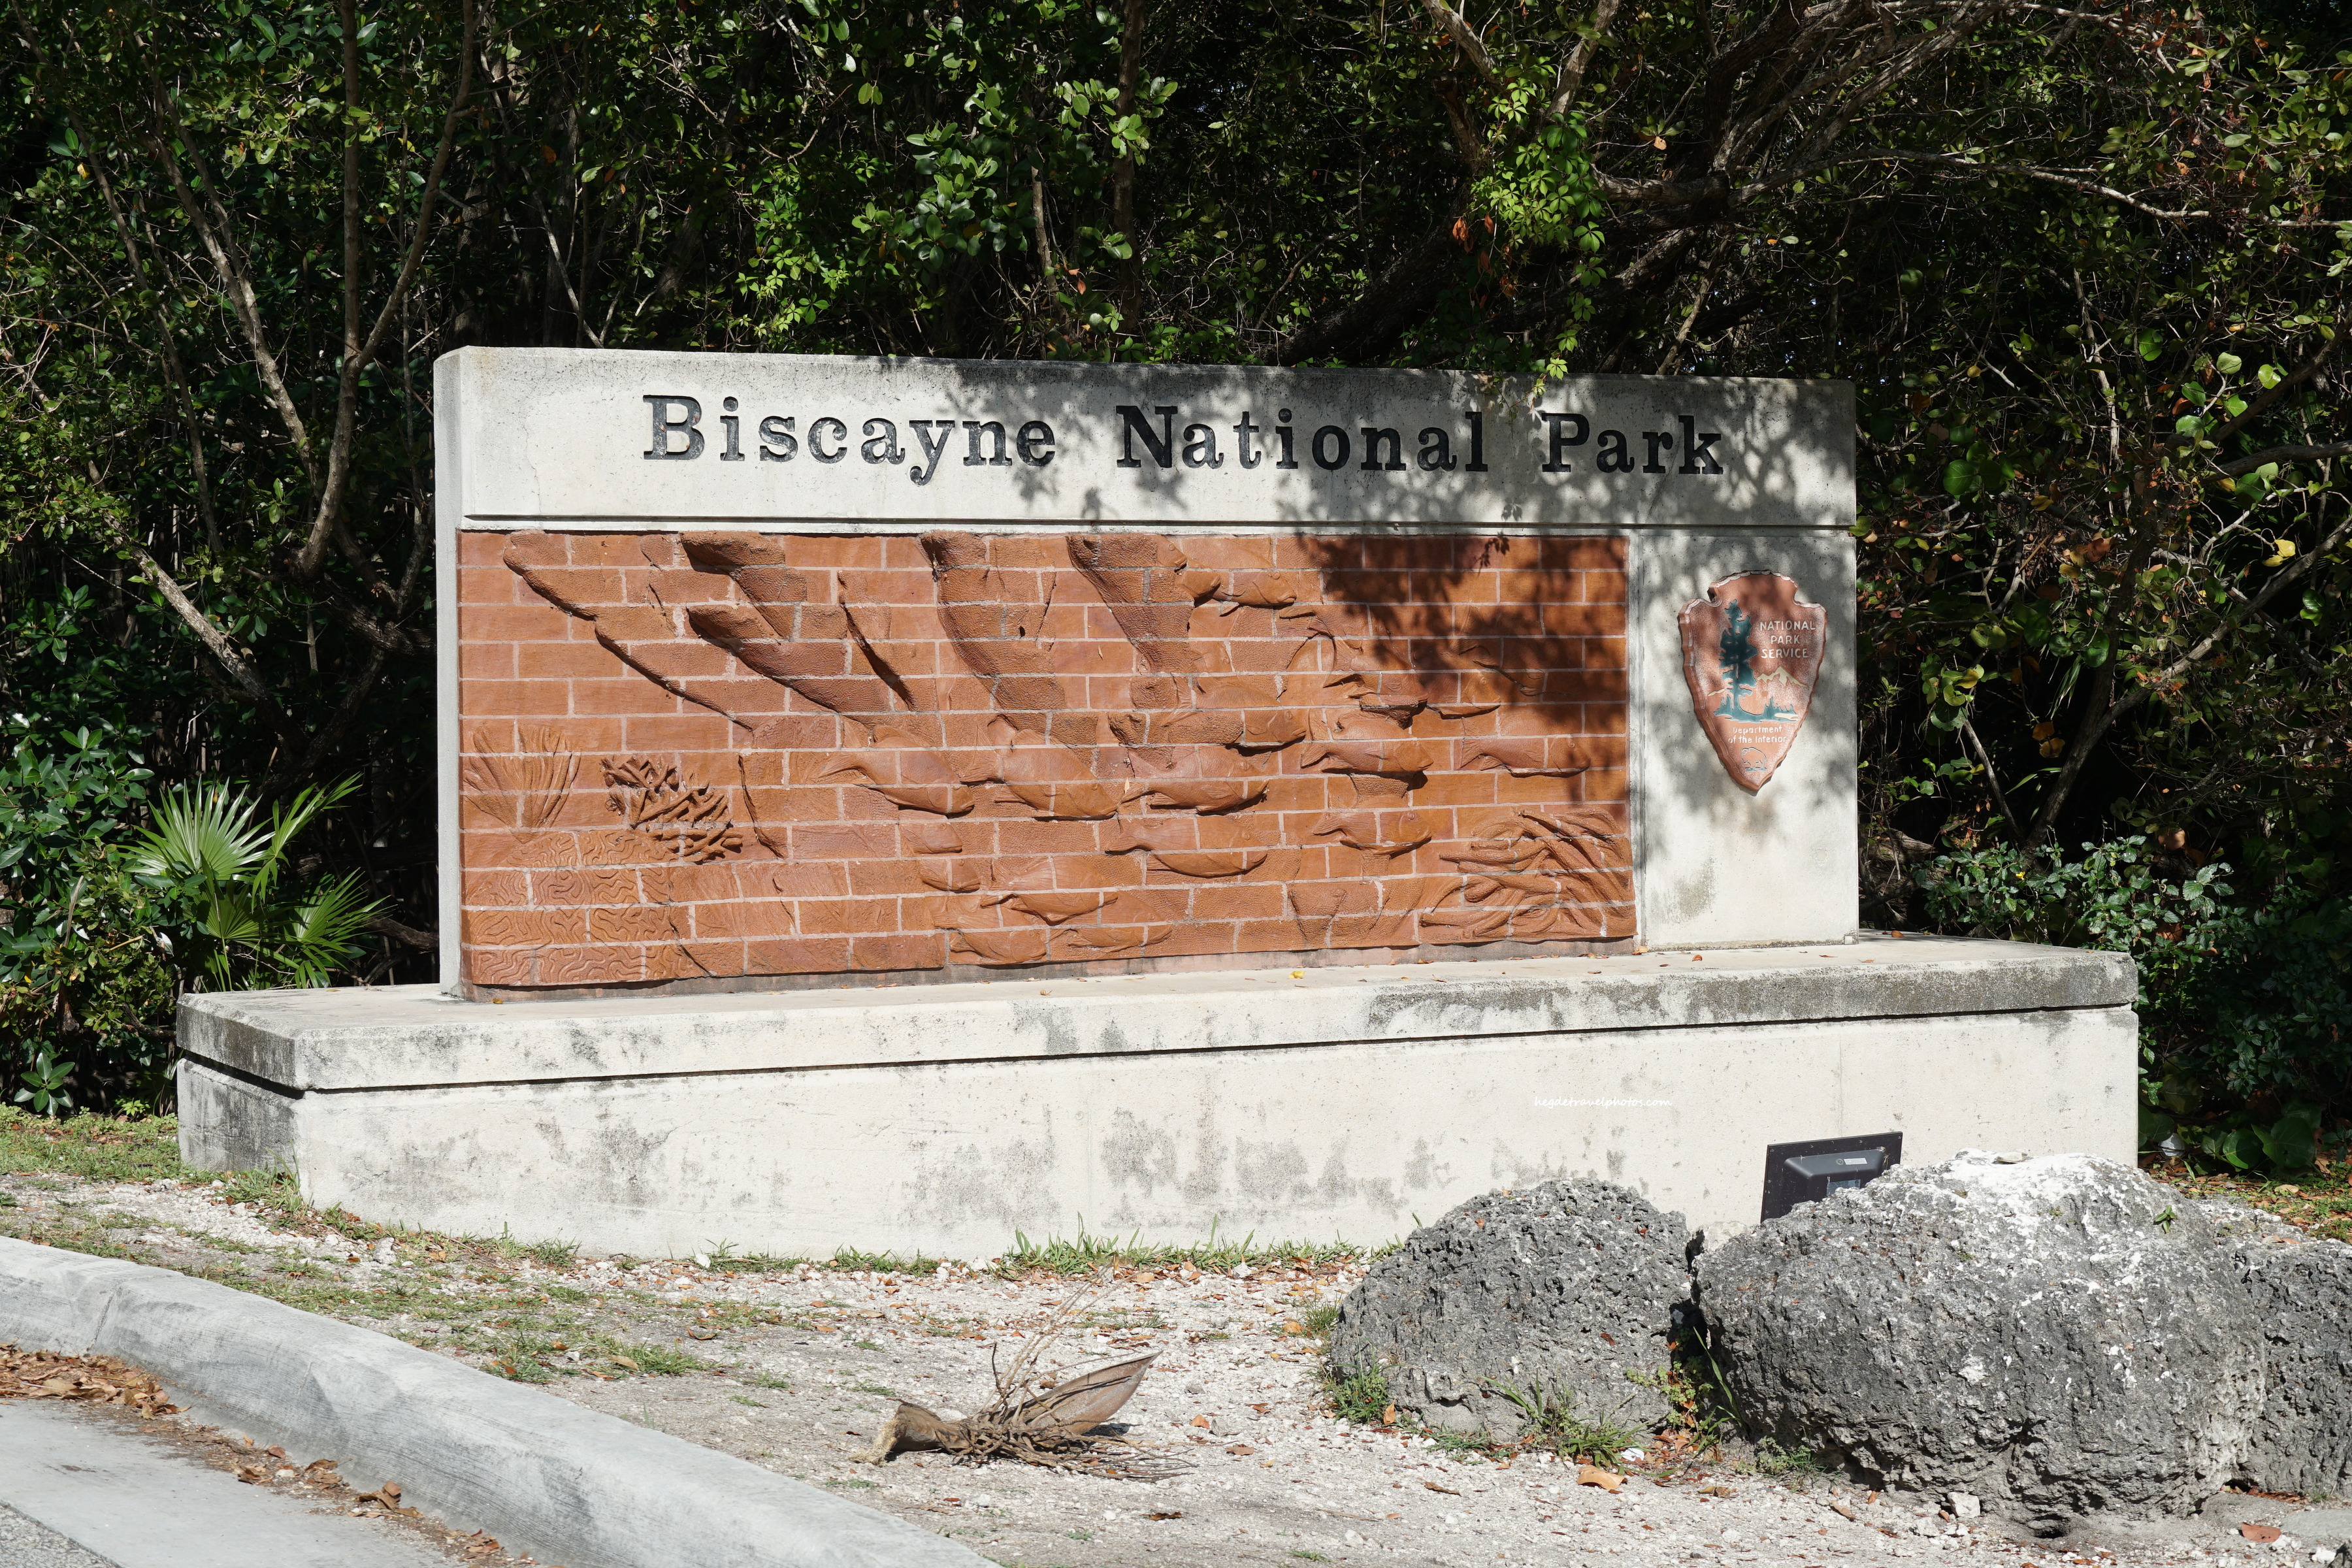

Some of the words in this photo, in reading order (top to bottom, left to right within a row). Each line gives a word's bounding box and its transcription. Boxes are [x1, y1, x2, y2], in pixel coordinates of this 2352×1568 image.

[642, 395, 1055, 486] Biscayne
[1115, 404, 1488, 472] National
[1540, 413, 1723, 475] Park
[1759, 620, 1816, 631] NATIONAL
[1771, 635, 1801, 645] PARK
[1761, 648, 1808, 659] SERVICE
[1733, 725, 1782, 735] Department
[1728, 735, 1737, 744] of
